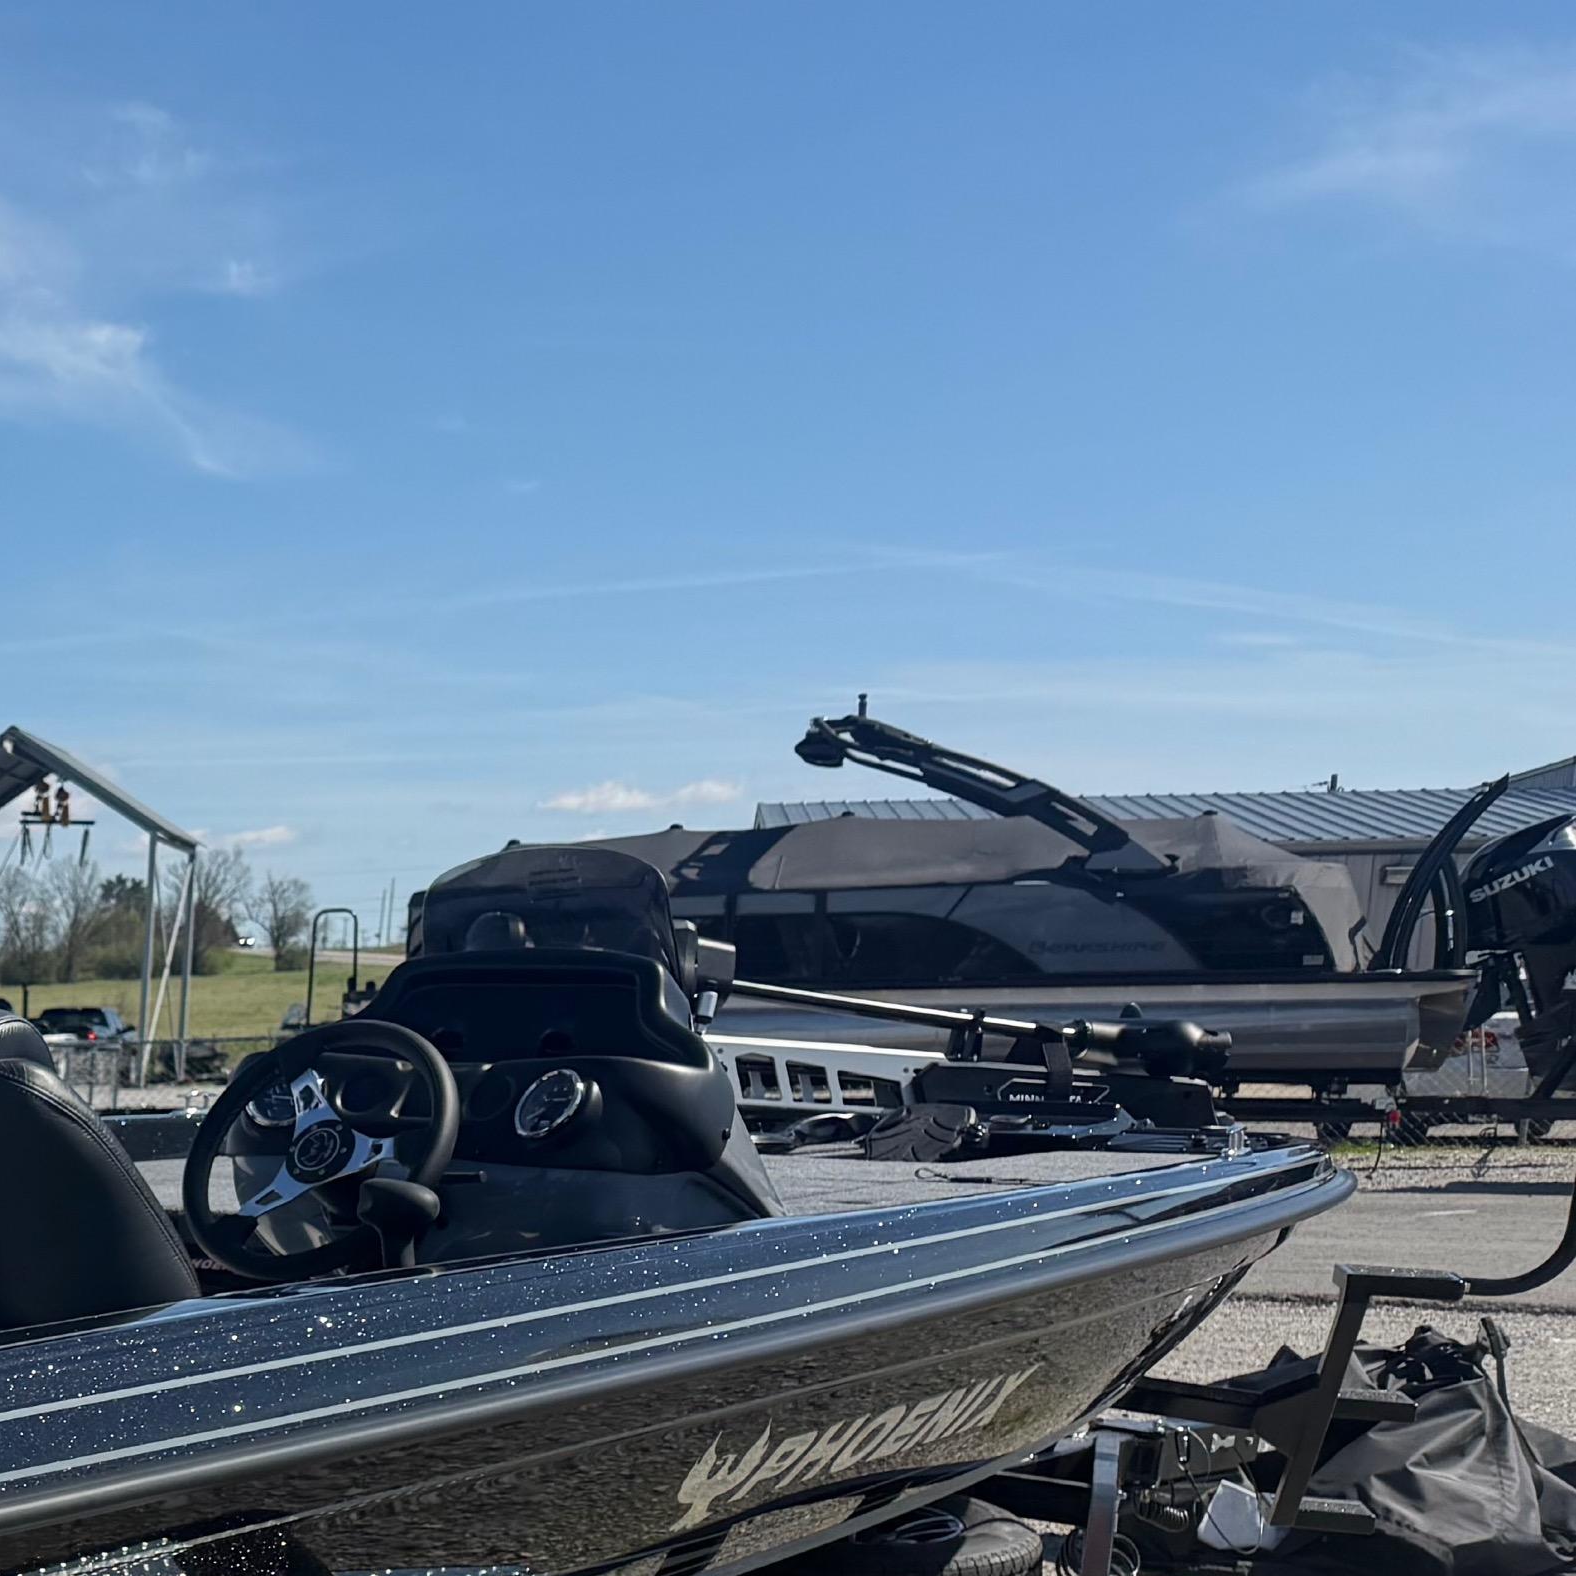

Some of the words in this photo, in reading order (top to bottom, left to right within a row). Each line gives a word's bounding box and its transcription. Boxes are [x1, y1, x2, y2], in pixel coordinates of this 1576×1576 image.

[1468, 855, 1555, 904] SUZUKI
[1008, 1093, 1045, 1102] MINN
[727, 1361, 1045, 1503] PHOENIX
